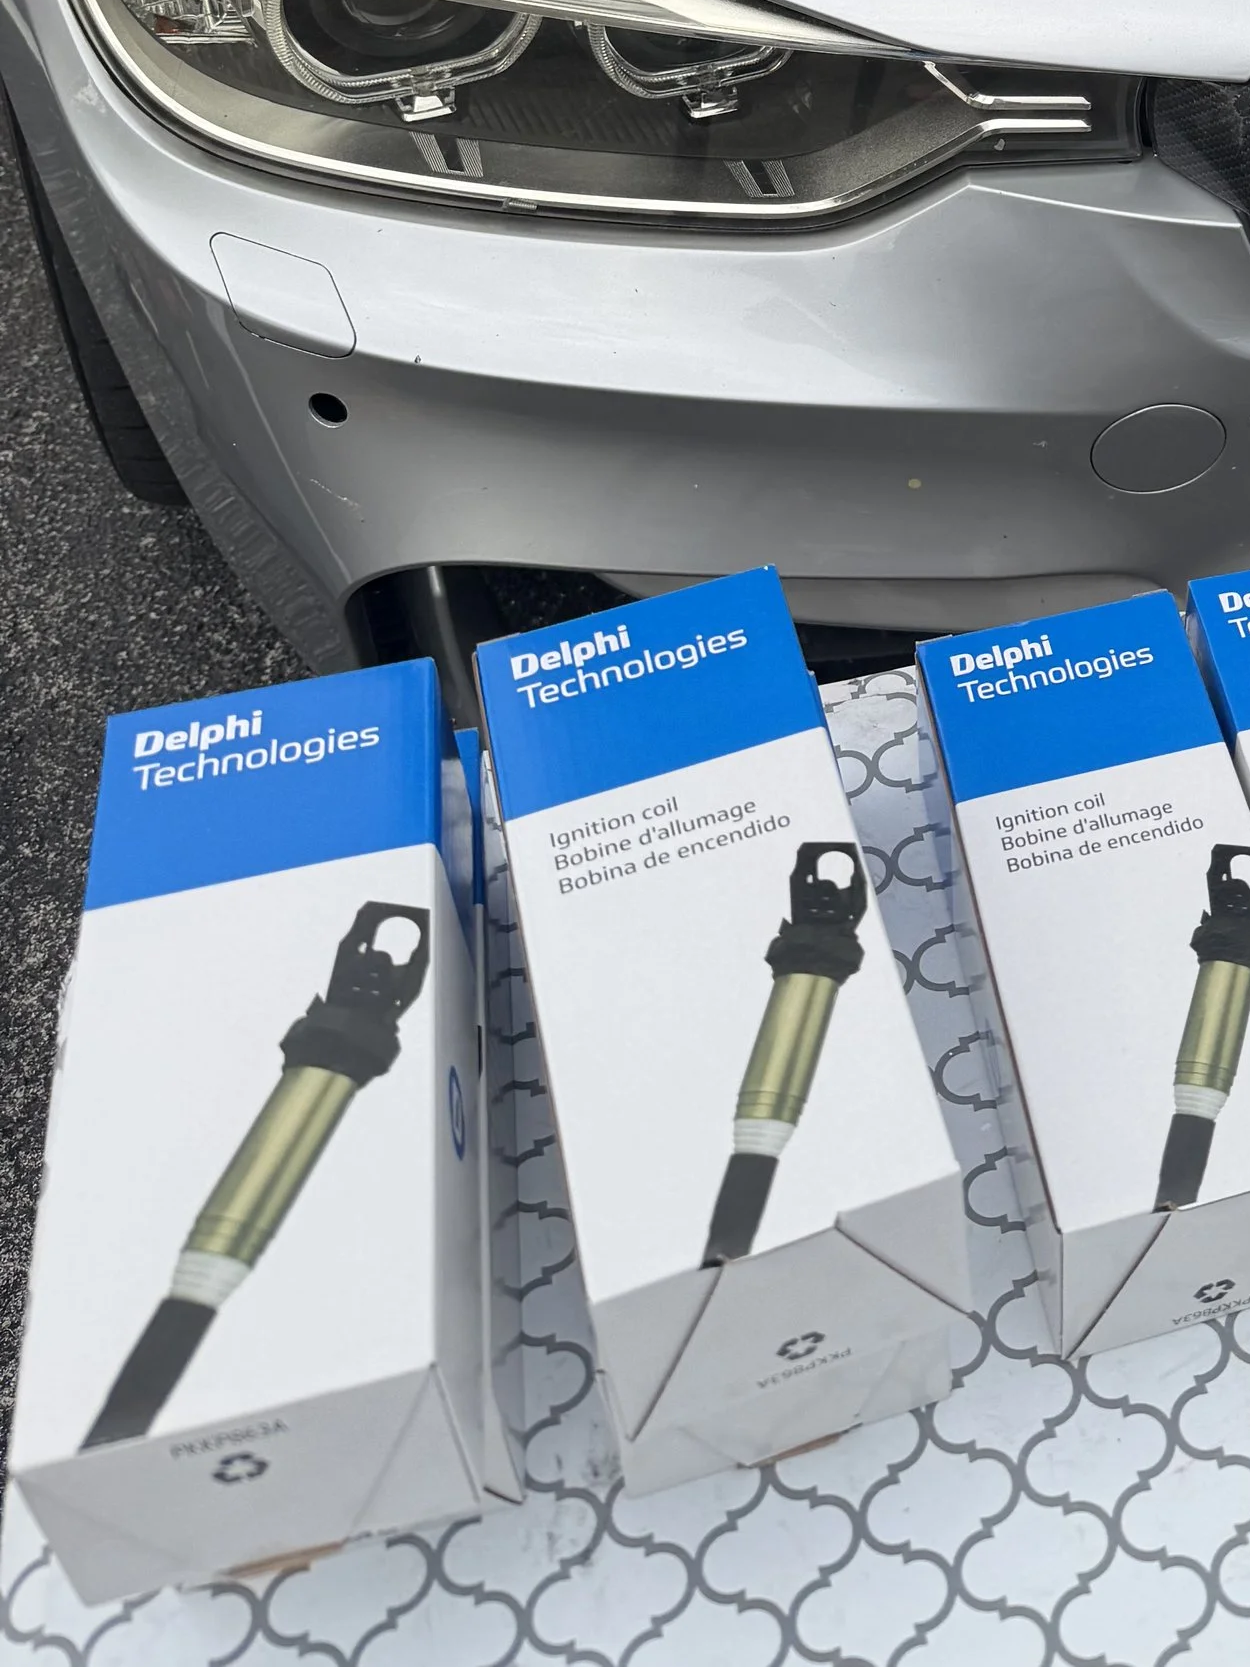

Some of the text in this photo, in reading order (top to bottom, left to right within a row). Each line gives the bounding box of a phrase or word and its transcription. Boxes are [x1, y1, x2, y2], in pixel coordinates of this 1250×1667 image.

[510, 624, 631, 681] Delphi
[517, 629, 748, 708] Technologies
[950, 634, 1053, 677] Delphi
[957, 647, 1154, 703] Technologies
[133, 727, 380, 790] Technologies
[134, 710, 263, 758] Delphi
[549, 796, 679, 850] Ignition coil
[554, 801, 756, 870] Bobine d'allumage
[996, 792, 1105, 832] Ignition coil
[1001, 803, 1173, 851] Bobine d'allumage
[558, 815, 791, 894] Bobina de encendido
[1006, 817, 1204, 873] Bobina de encendido
